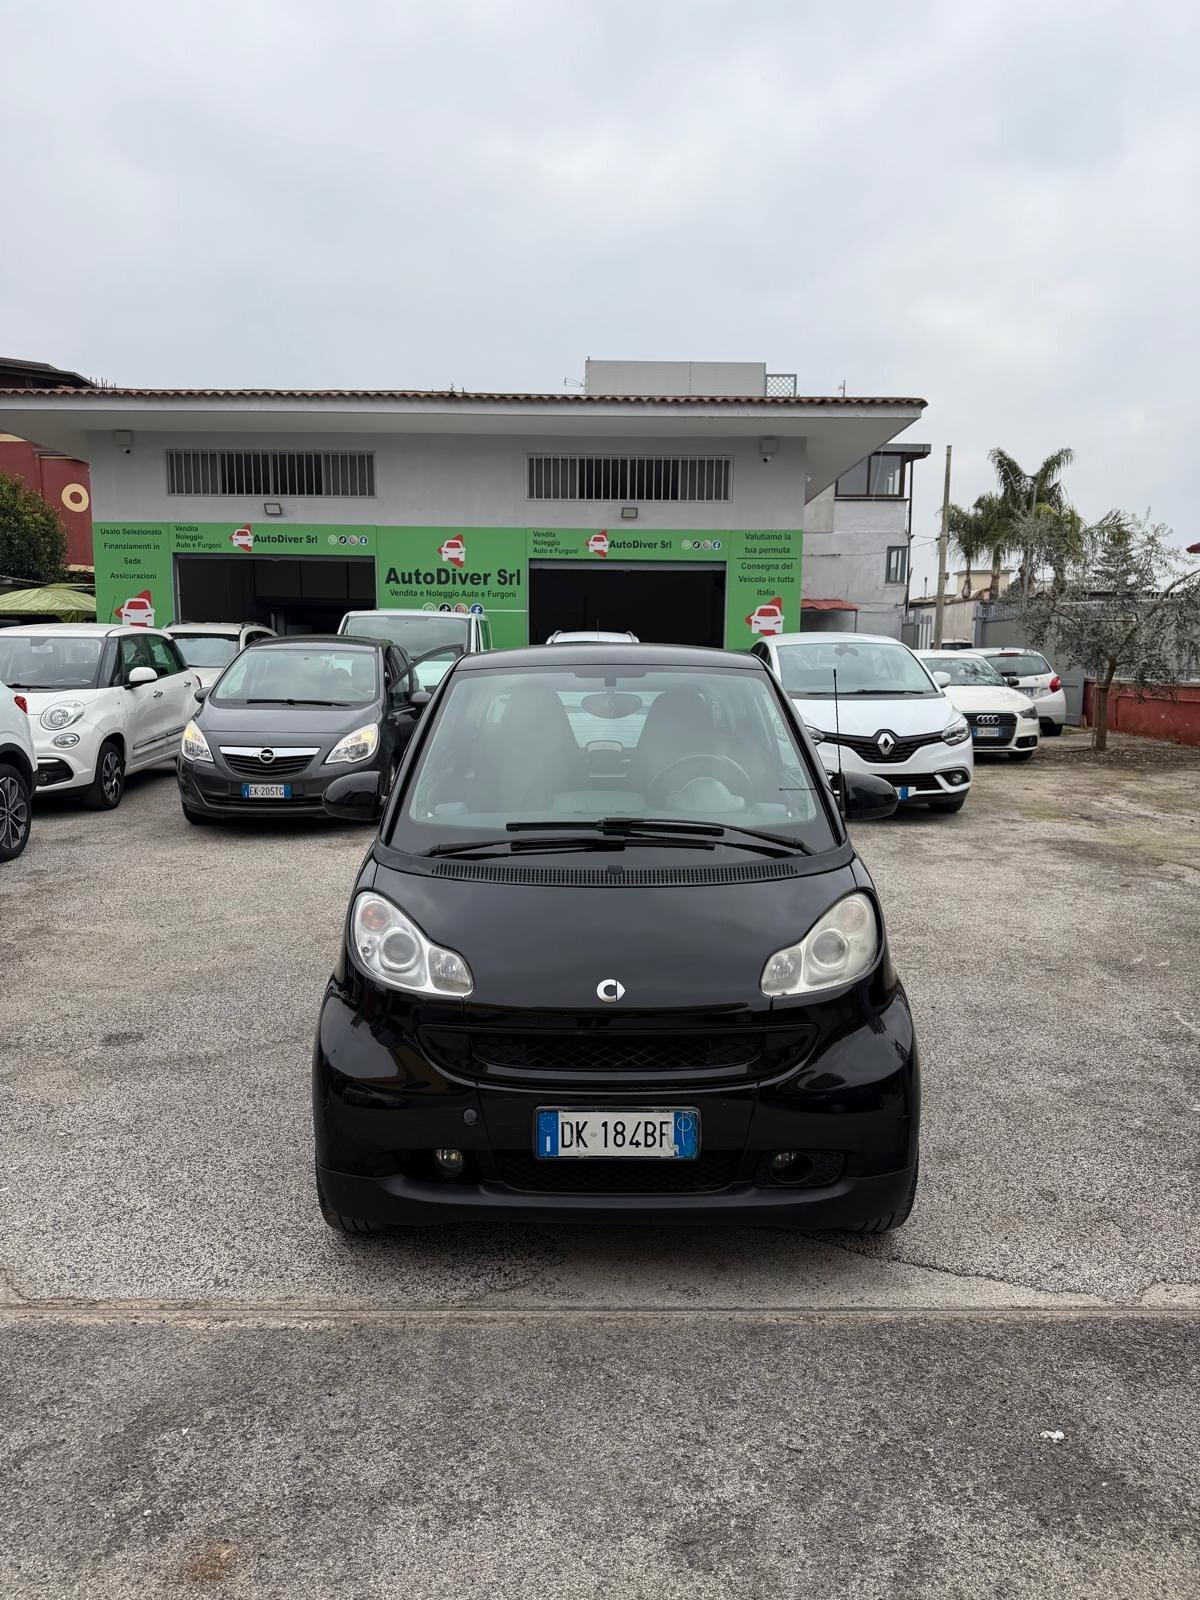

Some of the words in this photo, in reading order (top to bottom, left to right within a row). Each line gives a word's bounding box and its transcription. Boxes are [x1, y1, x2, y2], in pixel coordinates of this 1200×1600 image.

[100, 527, 120, 536] Usato
[121, 527, 162, 536] Selezionato
[175, 525, 199, 533] Vendita
[532, 530, 557, 538] Vendita
[175, 533, 204, 542] Noleggio
[253, 533, 304, 545] AutoDiver
[305, 534, 318, 544] Srl
[744, 532, 782, 542] Valutiamo
[783, 532, 792, 542] la
[103, 542, 151, 551] Finanziamenti
[152, 543, 160, 551] in
[175, 541, 192, 549] Auto
[198, 542, 223, 551] Furgoni
[532, 538, 561, 548] Noleggio
[608, 539, 659, 550] AutoDiver
[660, 540, 673, 550] Srl
[532, 546, 549, 555] Auto
[555, 547, 579, 556] Furgoni
[744, 546, 757, 555] tua
[758, 546, 791, 557] permuta
[123, 556, 142, 566] Sede
[740, 561, 779, 573] Consegna
[779, 562, 793, 571] del
[109, 571, 157, 580] Assicurazioni
[384, 567, 492, 587] AutoDiver
[496, 567, 521, 587] Srl
[738, 575, 766, 584] Veicolo
[767, 575, 775, 584] in
[777, 576, 795, 585] tutta
[389, 588, 417, 598] Vendita
[425, 589, 460, 600] Noleggio
[461, 590, 480, 599] Auto
[481, 591, 487, 599] e
[488, 590, 517, 600] Furgoni
[756, 588, 775, 597] Italia
[560, 1121, 589, 1149] DK
[601, 1120, 672, 1149] 184BF
